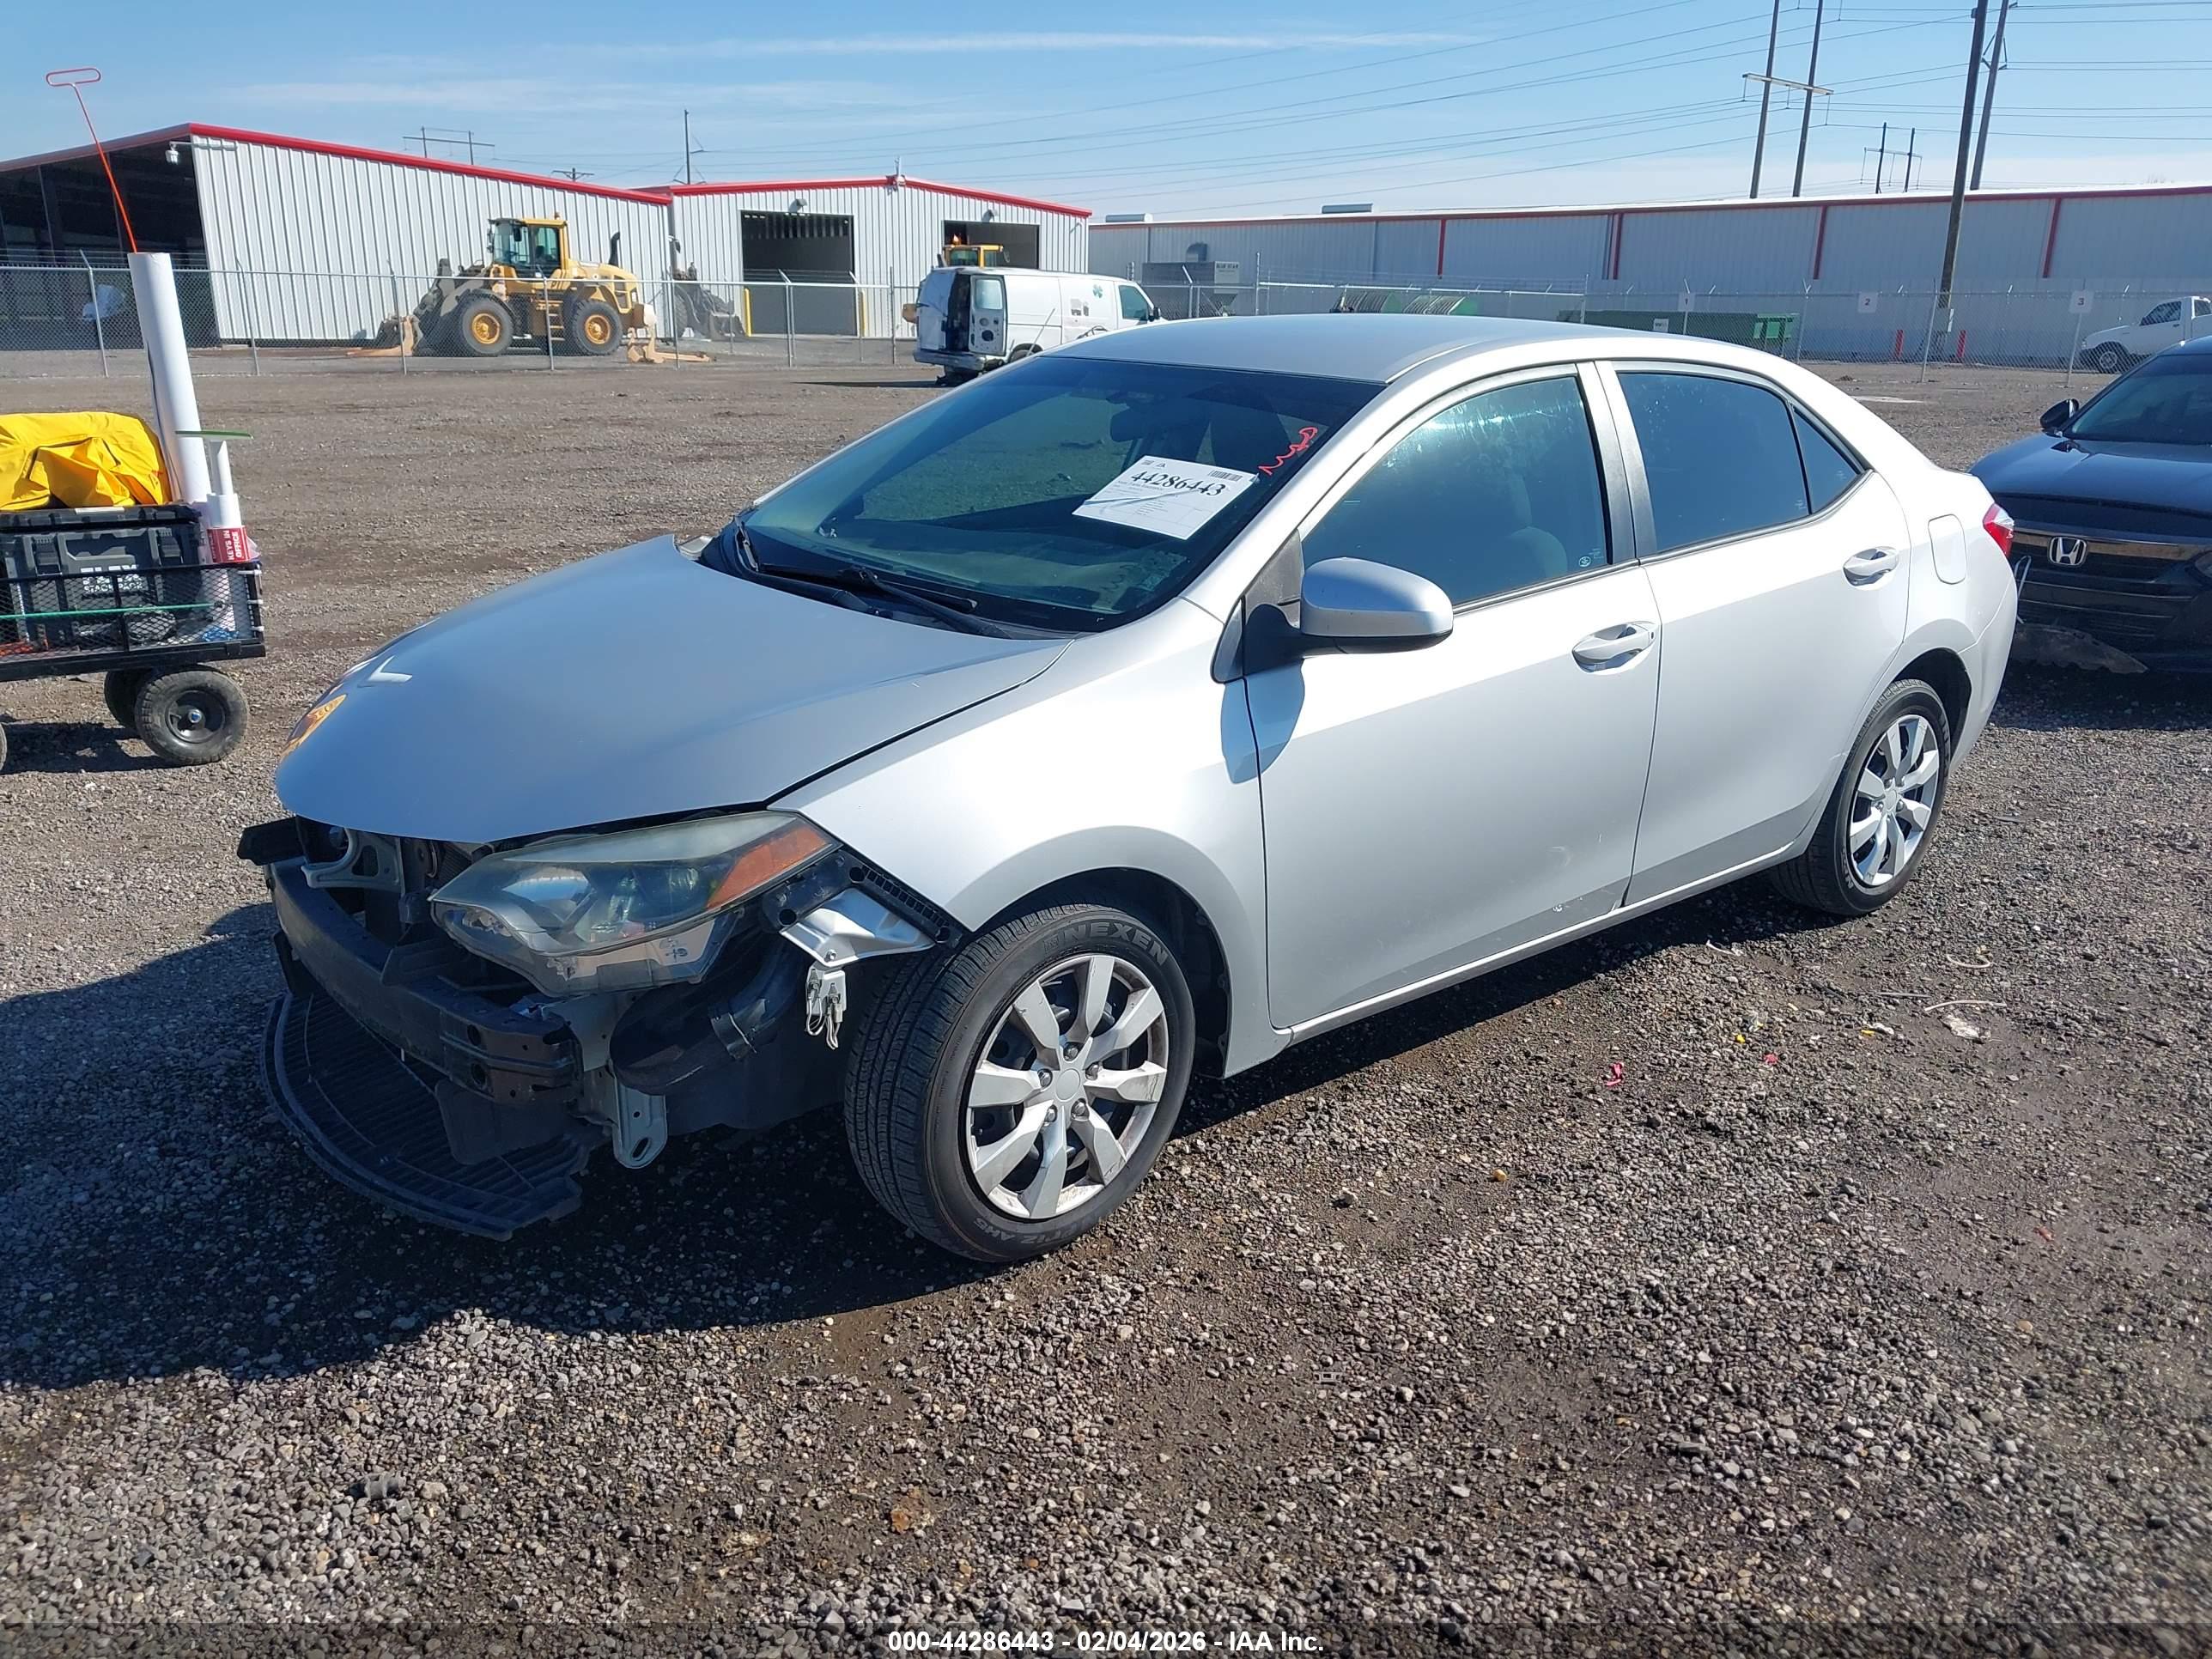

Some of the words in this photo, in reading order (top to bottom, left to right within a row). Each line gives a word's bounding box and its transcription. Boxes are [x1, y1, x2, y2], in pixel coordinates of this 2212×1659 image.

[2077, 297, 2085, 306] 3
[1131, 471, 1226, 496] 44286443
[222, 530, 231, 539] IN
[232, 531, 242, 558] OFFICE
[225, 539, 234, 561] KEYS
[1063, 921, 1169, 966] NEXEN
